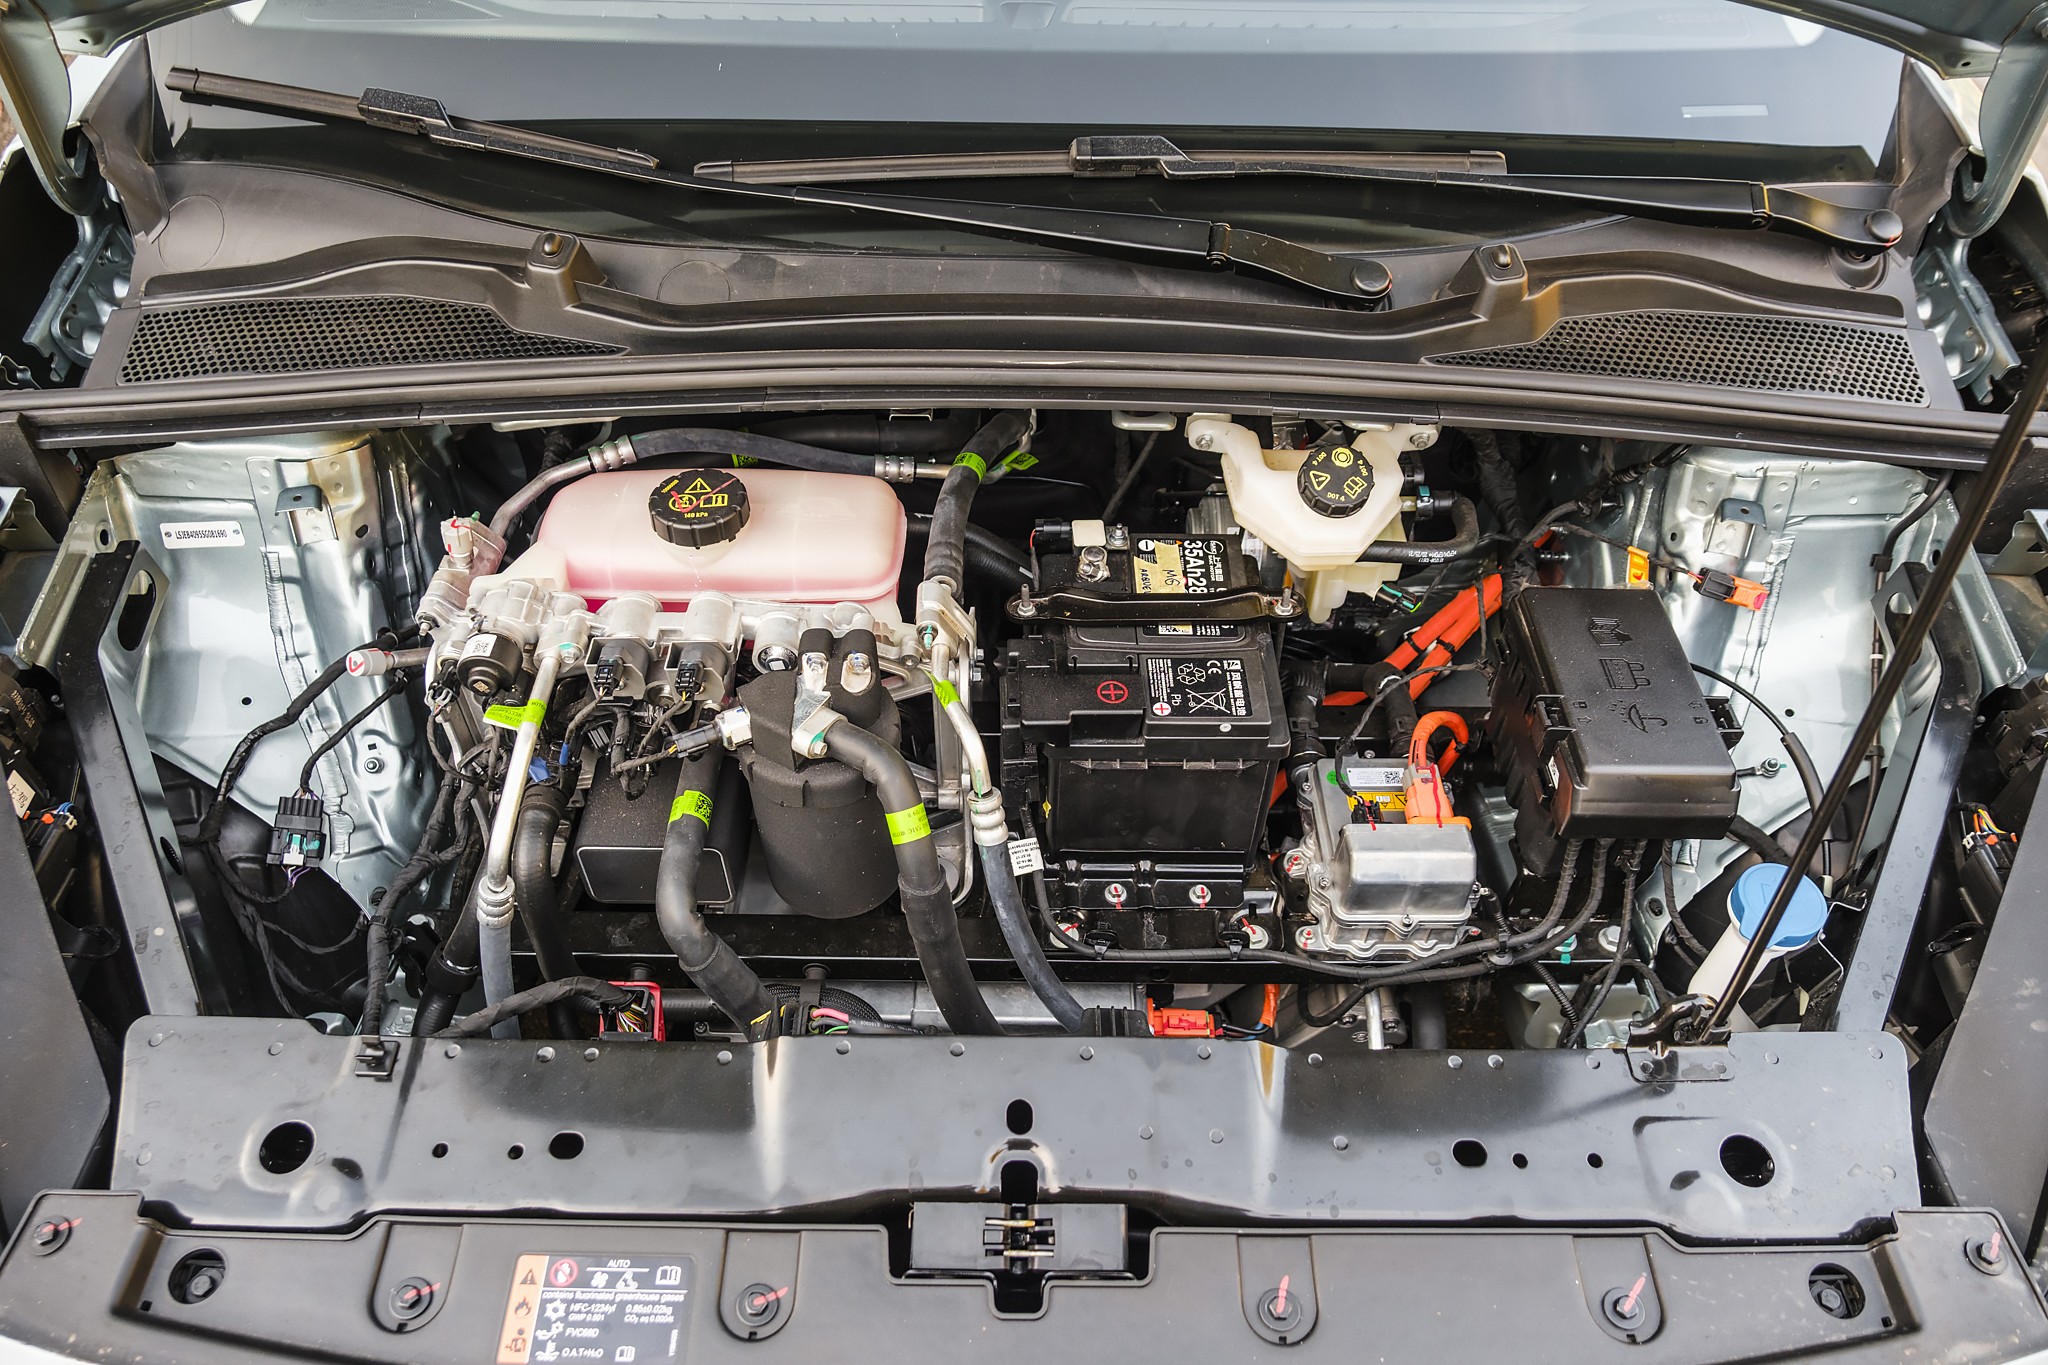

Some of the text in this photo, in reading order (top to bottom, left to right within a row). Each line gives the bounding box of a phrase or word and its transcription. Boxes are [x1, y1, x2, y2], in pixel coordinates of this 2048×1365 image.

[1326, 491, 1340, 500] DOT
[1170, 693, 1182, 706] Pb
[606, 1259, 631, 1268] AUTO
[542, 1291, 685, 1303] contains fluorinated greenhouse gases
